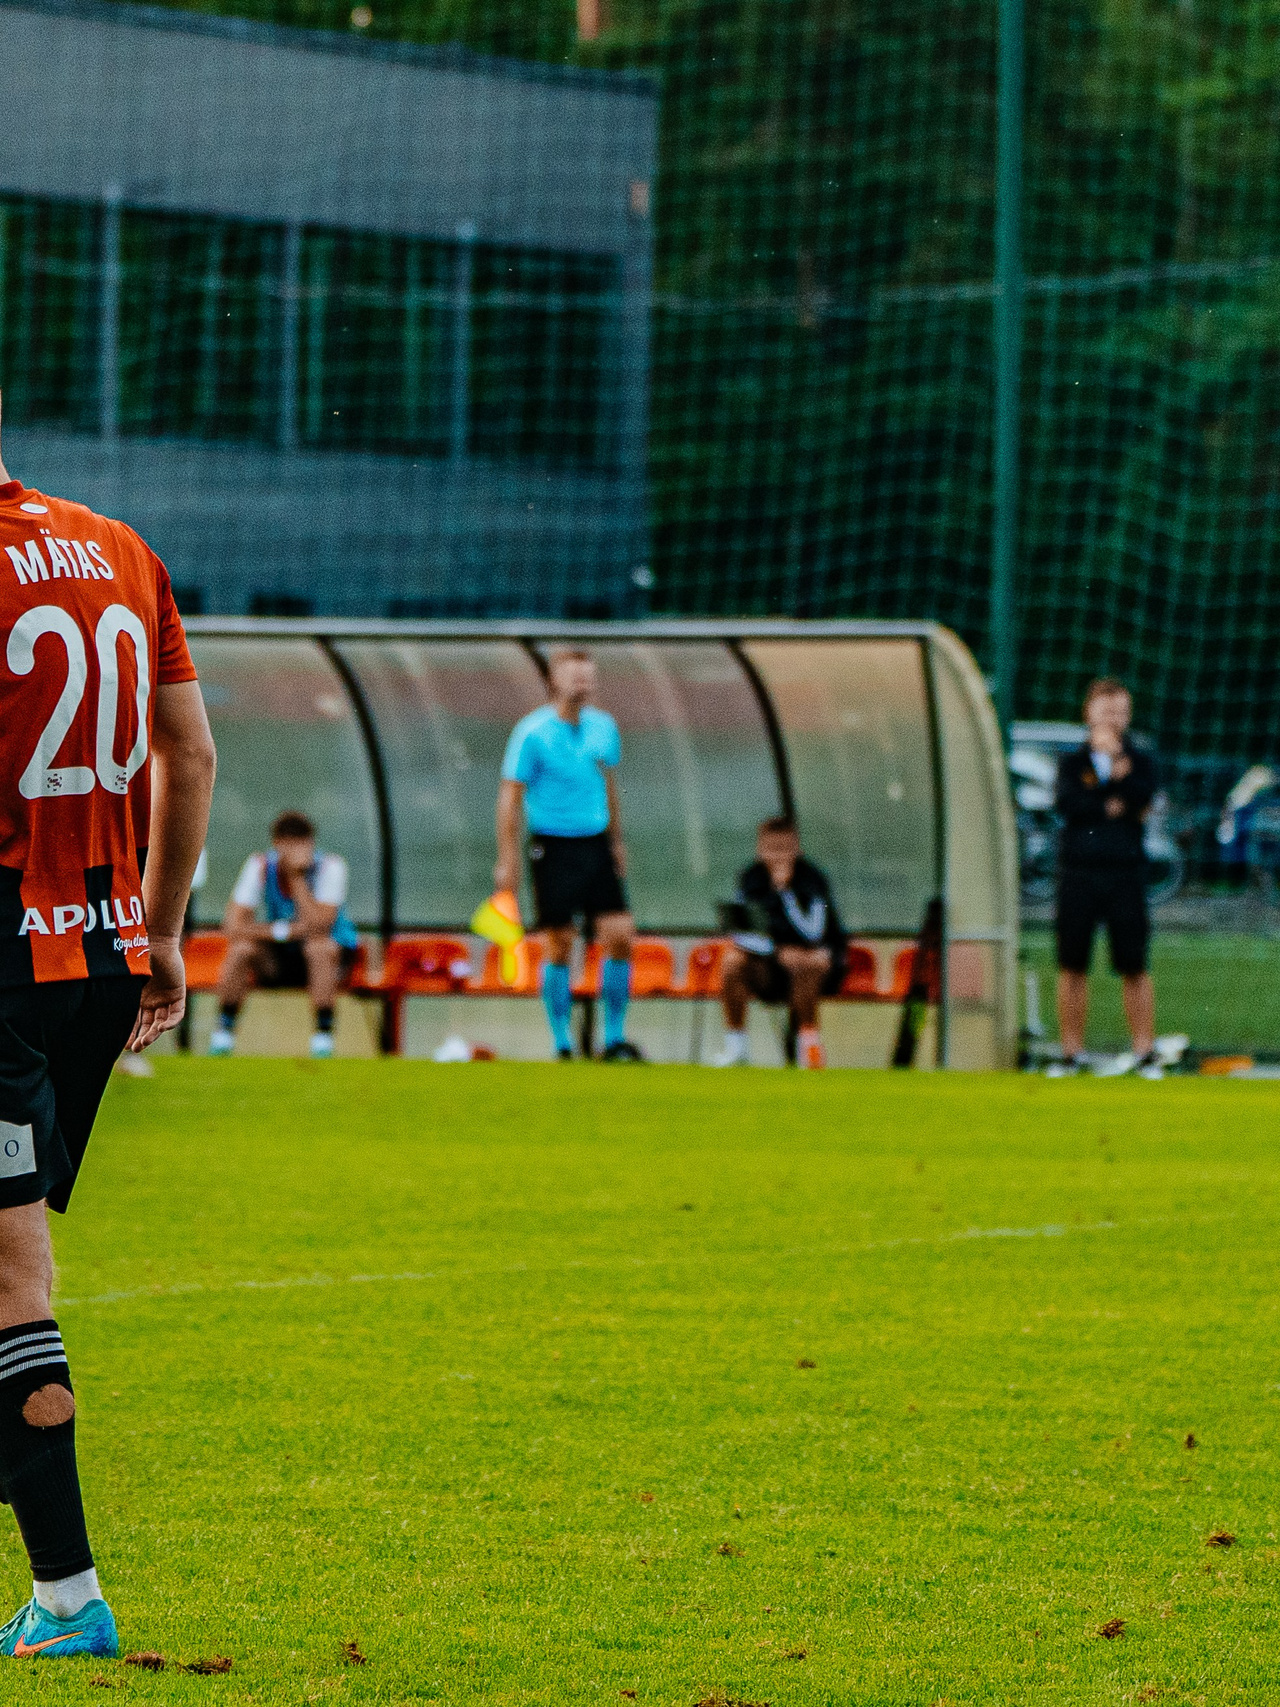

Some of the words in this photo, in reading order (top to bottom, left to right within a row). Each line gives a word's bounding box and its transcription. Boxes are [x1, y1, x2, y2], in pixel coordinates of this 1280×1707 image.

[4, 528, 114, 585] MÄTAS
[6, 603, 149, 800] 20
[18, 896, 143, 935] APOLLO
[113, 937, 133, 955] Kogu
